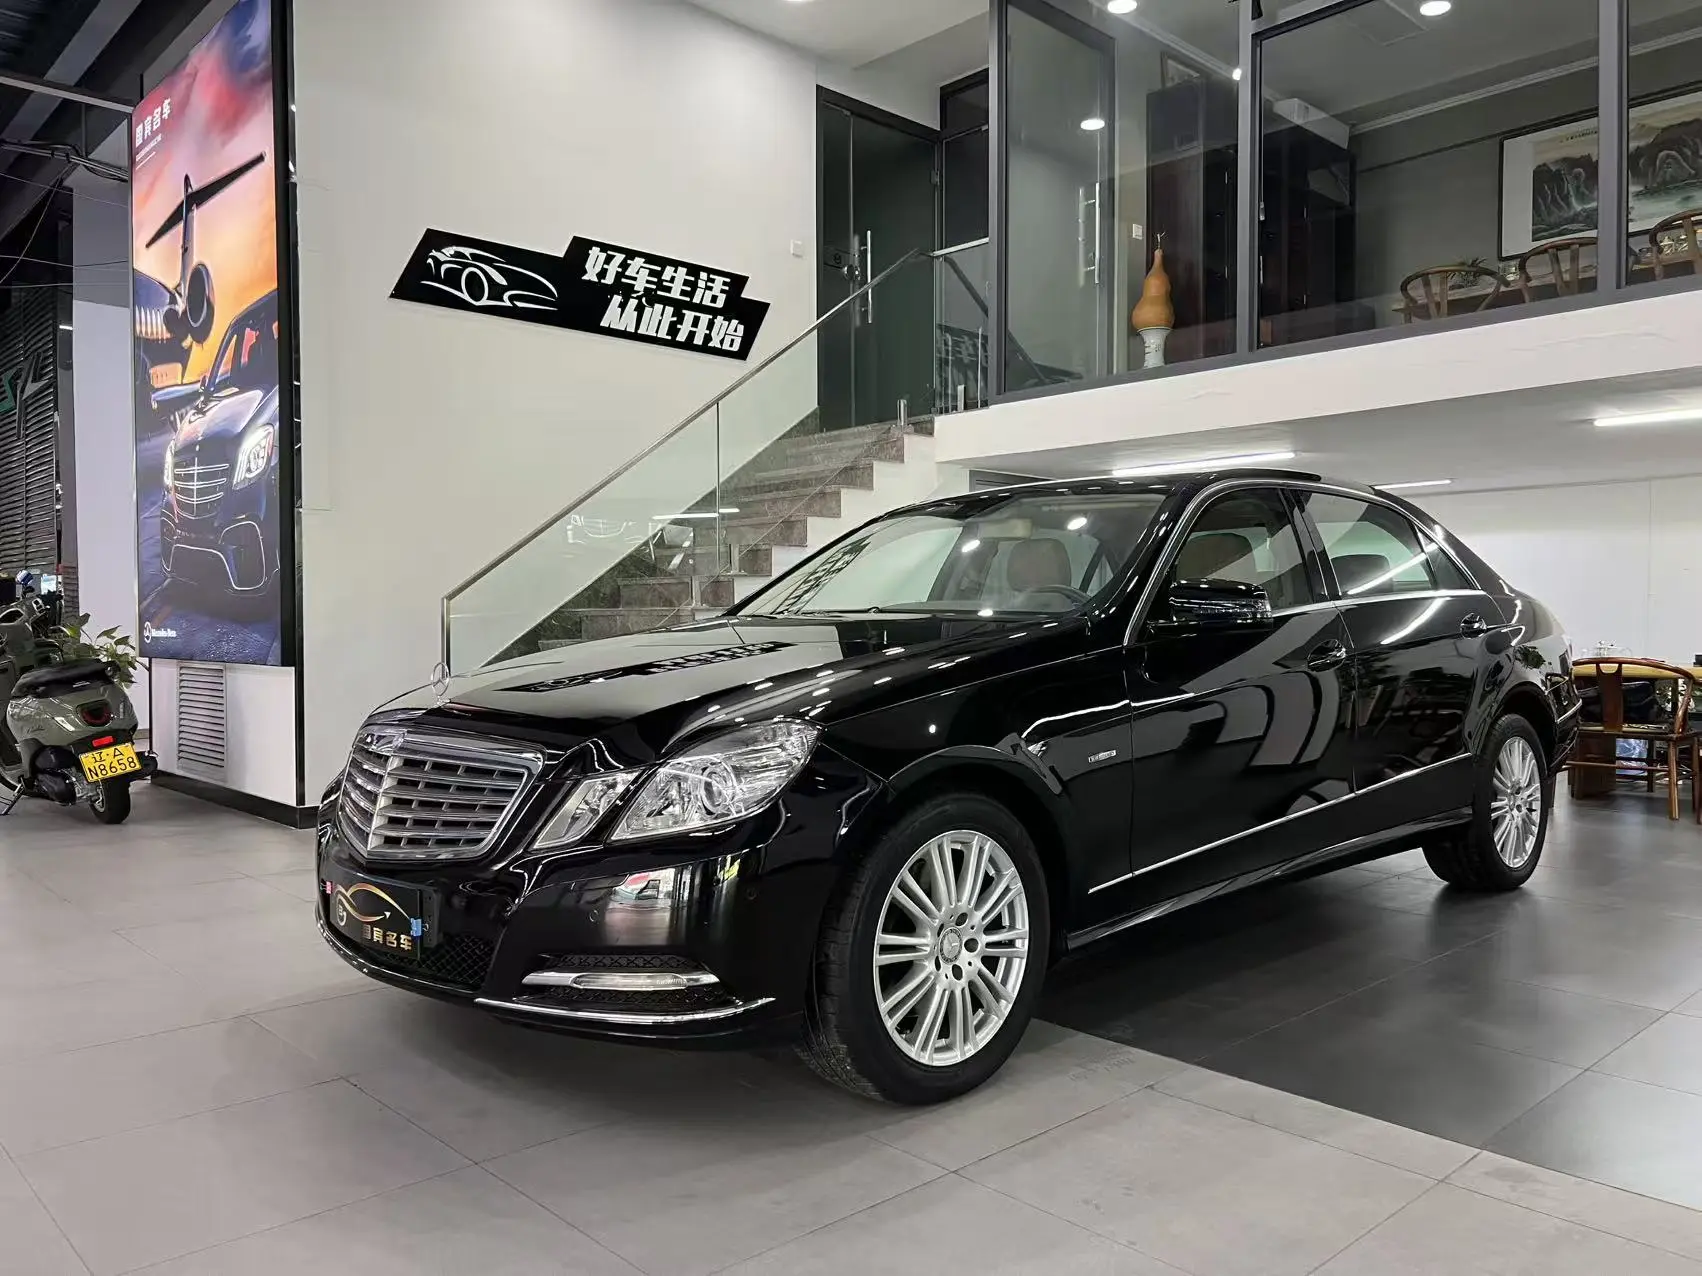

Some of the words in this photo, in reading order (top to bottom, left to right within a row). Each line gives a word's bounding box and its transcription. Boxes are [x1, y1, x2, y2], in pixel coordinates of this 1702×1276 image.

[581, 246, 732, 309] 好车生活
[600, 295, 745, 352] 从此开始
[87, 756, 137, 780] N8658
